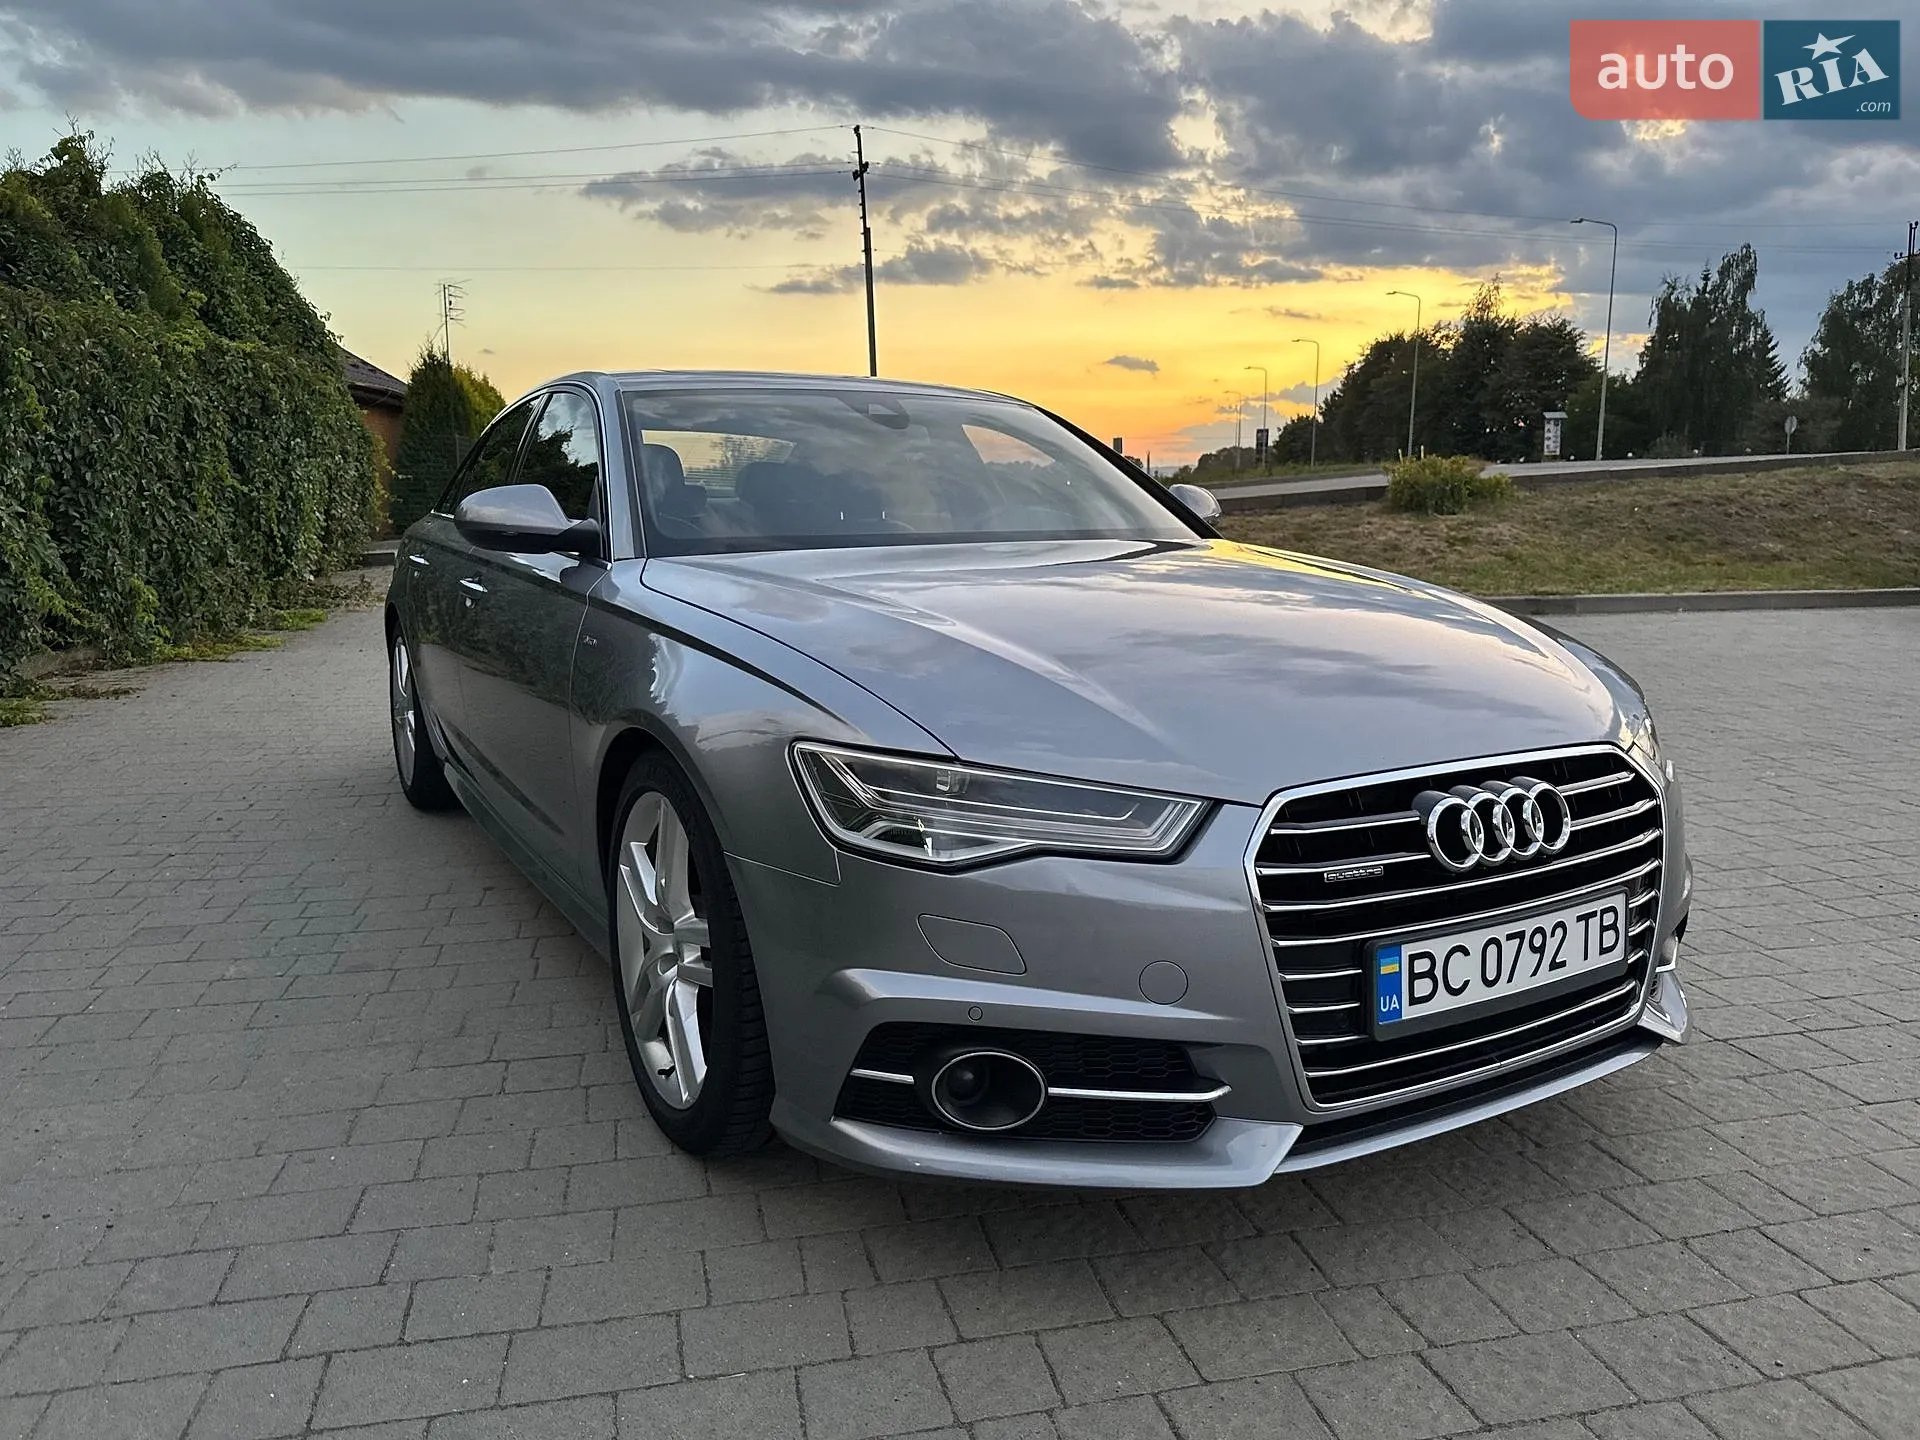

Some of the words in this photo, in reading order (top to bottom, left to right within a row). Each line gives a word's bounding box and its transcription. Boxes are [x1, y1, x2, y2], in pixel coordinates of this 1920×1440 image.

[1327, 867, 1381, 880] quattro
[1408, 943, 1471, 1007] BC
[1480, 920, 1568, 988] 0792
[1575, 904, 1620, 962] TB
[1380, 994, 1400, 1012] UA
